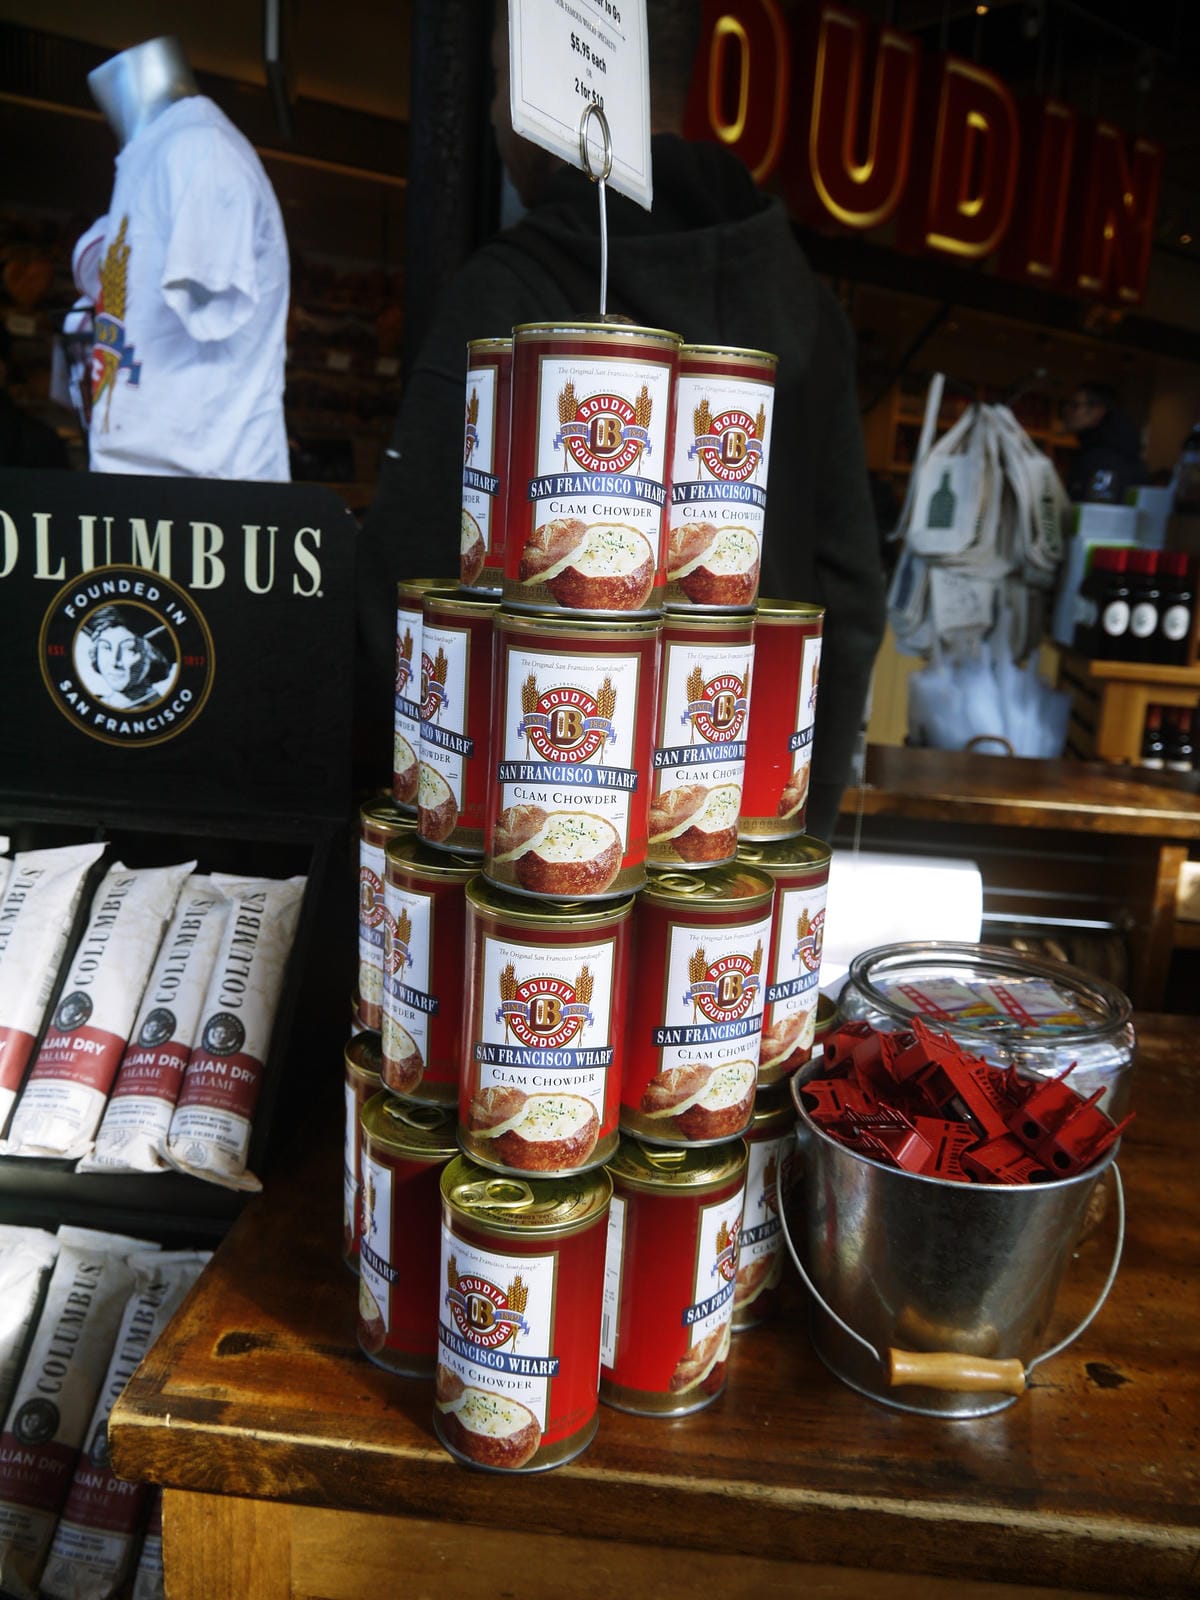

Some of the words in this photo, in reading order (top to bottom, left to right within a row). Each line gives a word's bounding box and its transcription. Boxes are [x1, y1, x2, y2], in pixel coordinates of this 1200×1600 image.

[612, 5, 621, 24] Go
[571, 32, 590, 60] $5.95
[591, 53, 607, 75] each
[575, 77, 580, 93] 2
[581, 81, 591, 100] for
[592, 89, 604, 112] $10
[558, 367, 568, 375] The
[580, 398, 634, 421] BOUDIN
[562, 426, 587, 435] SINCE
[714, 414, 755, 436] BOUDIN
[696, 438, 718, 447] SINCE
[571, 440, 638, 472] SOURDOUGH
[705, 451, 756, 481] SOURDOUGH
[530, 479, 553, 497] SAN
[556, 476, 631, 493] FRANCISCO
[634, 480, 667, 503] WHARF
[672, 486, 687, 501] AN
[690, 484, 750, 500] FRANCISCO
[550, 501, 587, 515] CLAM
[592, 504, 652, 517] CHOWDER
[682, 506, 717, 519] CLAM
[64, 579, 160, 618] FOUNDED
[166, 602, 187, 626] IN
[531, 660, 554, 669] Original
[706, 678, 743, 696] BOUDIN
[60, 679, 89, 716] SAN
[94, 688, 192, 734] FRANCISCO
[541, 691, 595, 713] BOUDIN
[525, 716, 547, 726] SINCE
[697, 713, 743, 742] SOURDOUGH
[435, 728, 471, 754] WHARF
[533, 731, 599, 762] SOURDOUGH
[791, 732, 806, 749] SAN
[654, 750, 679, 767] SAN
[682, 745, 738, 763] FRANCISCO
[500, 765, 517, 780] SAN
[520, 766, 593, 783] FRANCISCO
[596, 770, 635, 788] WHARF
[676, 770, 709, 781] CLAM
[513, 787, 547, 802] CLAM
[553, 792, 617, 804] CHOWDER
[74, 876, 138, 986] COLUMBUS
[155, 899, 216, 1004] COLUMBUS
[218, 891, 266, 1009] COLUMBUS
[510, 950, 533, 960] Original
[709, 958, 752, 978] BOUDIN
[400, 987, 434, 1012] WHARF
[520, 981, 573, 1001] BOUDIN
[769, 984, 790, 1001] SAN
[503, 1003, 526, 1013] SINCE
[700, 991, 753, 1022] SOURDOUGH
[512, 1017, 578, 1047] SOURDOUGH
[656, 1029, 682, 1044] SAN
[685, 1021, 747, 1043] FRANCISCO
[72, 1038, 106, 1056] DRY
[476, 1045, 496, 1060] SAN
[498, 1049, 571, 1066] FRANCISCO
[575, 1050, 612, 1066] WHARF
[678, 1049, 713, 1060] CLAM
[158, 1054, 187, 1071] DRY
[231, 1066, 256, 1085] DRY
[492, 1069, 527, 1085] CLAM
[532, 1073, 595, 1087] CHOWDER
[460, 1280, 507, 1306] BOUDIN
[500, 1311, 519, 1321] 1849
[686, 1301, 709, 1323] SAN
[36, 1262, 104, 1395] COLUMBUS
[455, 1306, 511, 1346] SOURDOUGH
[446, 1334, 505, 1368] FRANCISCO
[509, 1357, 556, 1374] WHARF
[442, 1349, 465, 1374] CLAM
[468, 1369, 532, 1389] CHOWDER
[38, 1456, 66, 1472] DRY
[106, 1479, 139, 1496] DRY
